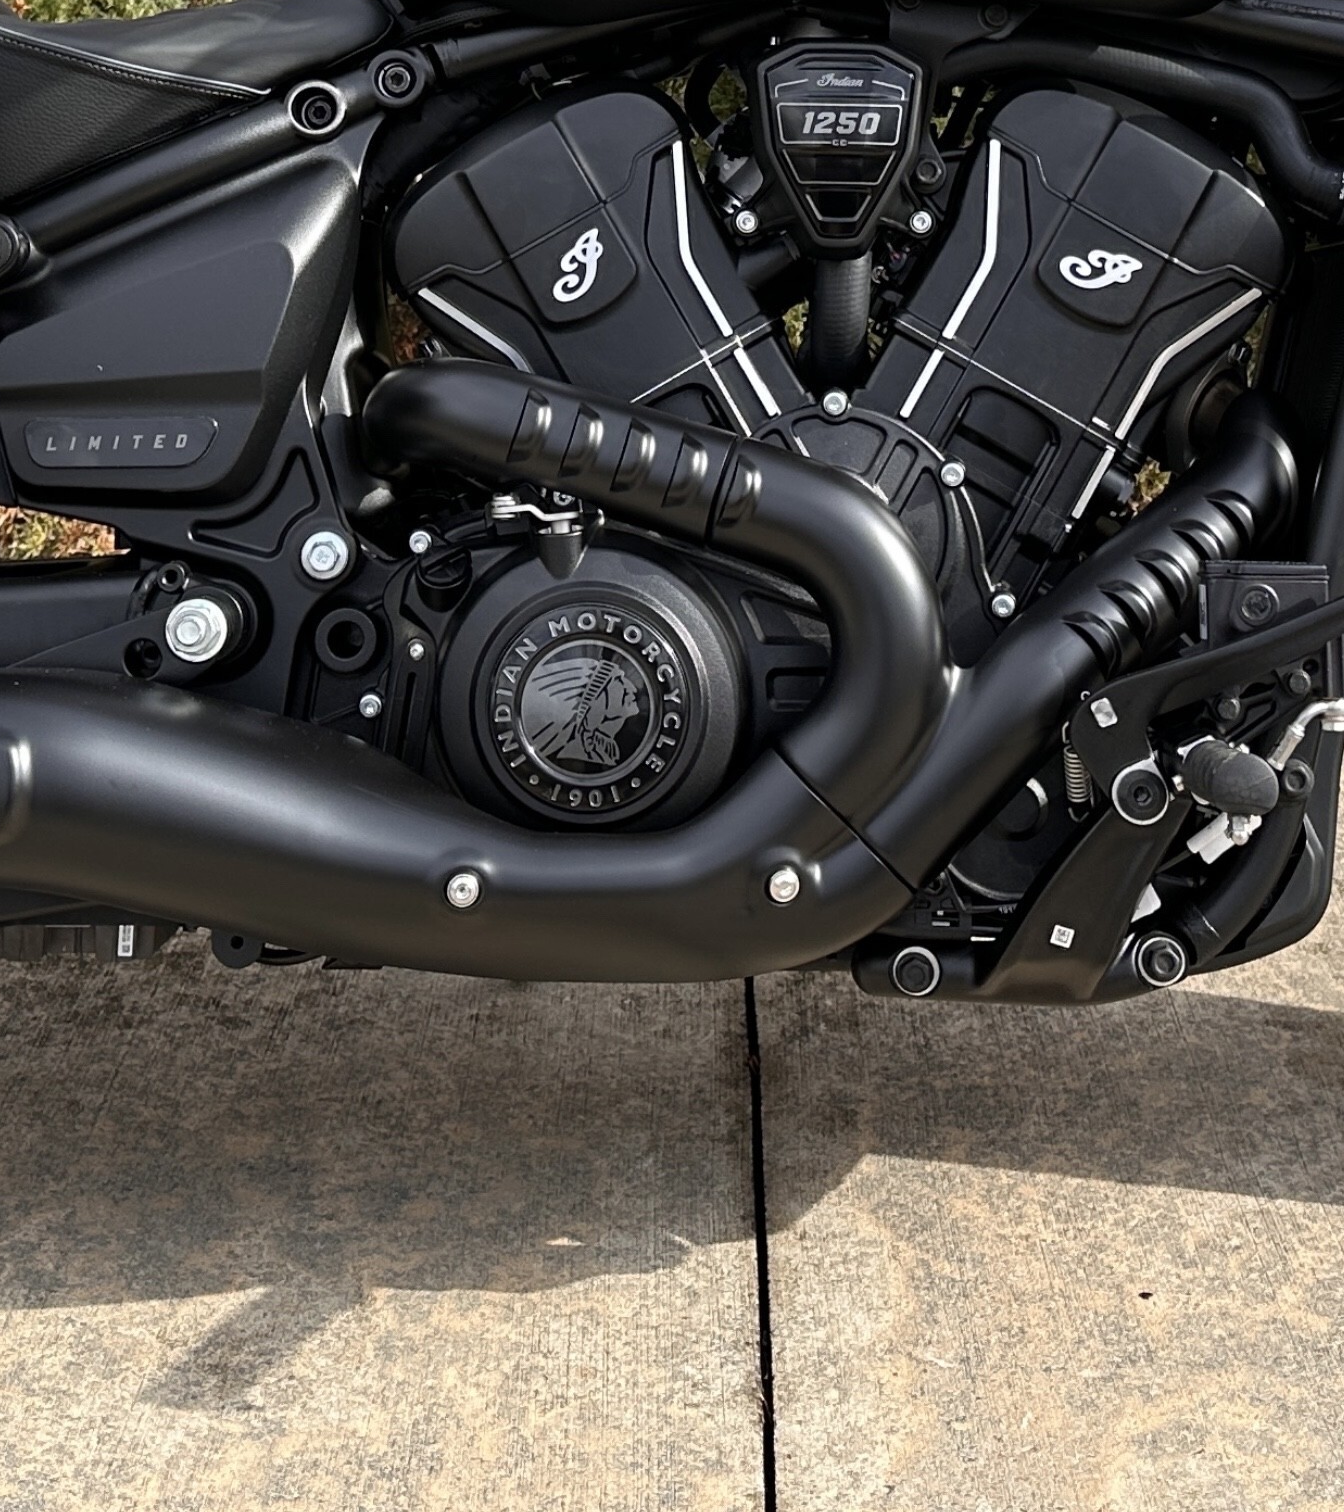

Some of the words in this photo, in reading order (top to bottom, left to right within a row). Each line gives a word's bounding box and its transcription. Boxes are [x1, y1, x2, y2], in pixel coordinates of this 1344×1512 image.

[816, 72, 864, 87] Indian
[802, 111, 881, 135] 1250
[46, 434, 188, 452] LIMITED
[494, 637, 538, 768] INDIAN
[548, 612, 682, 773] MOTORCYCLE
[550, 784, 621, 808] 1901
